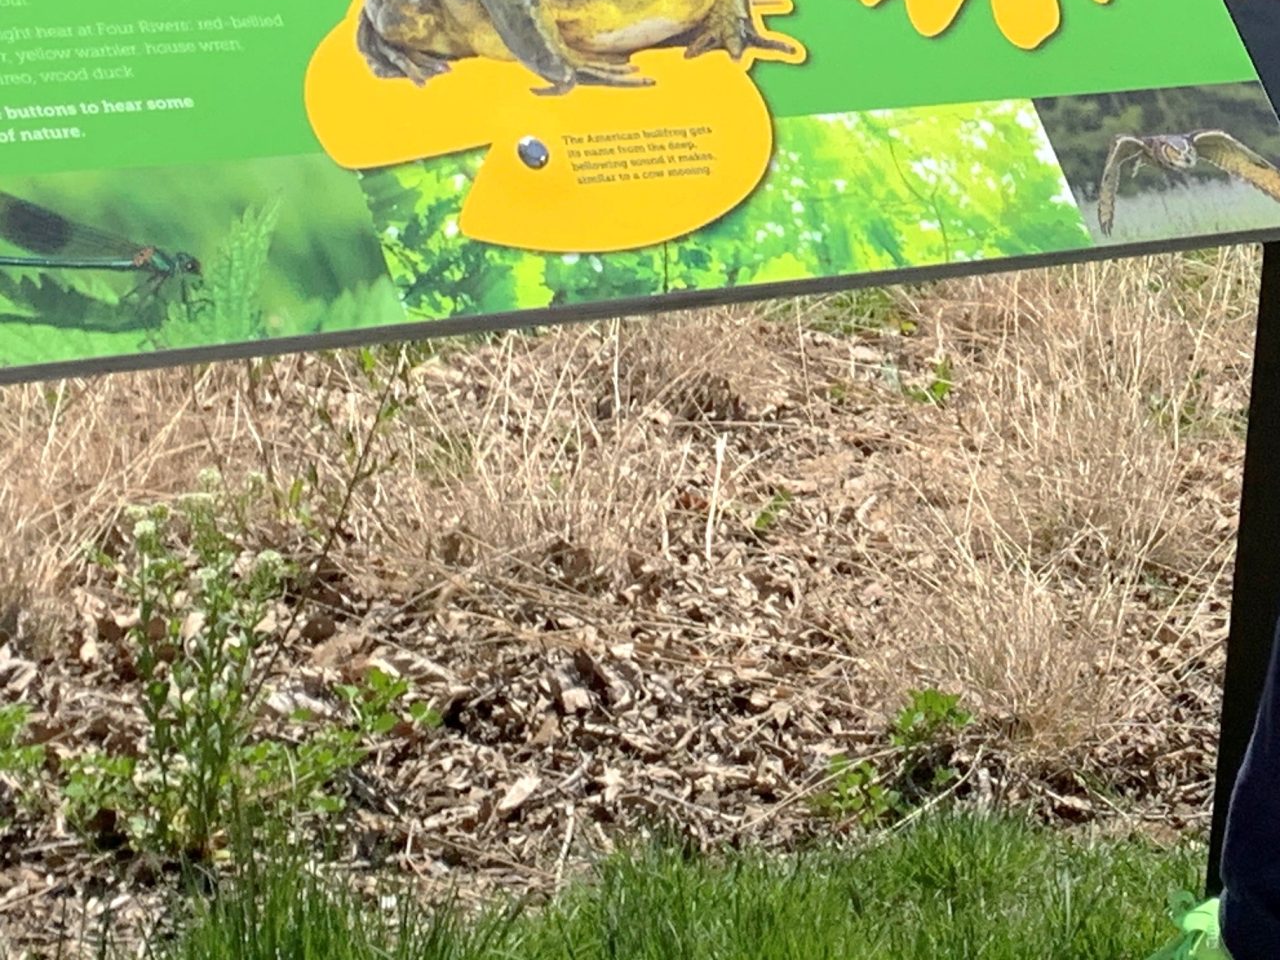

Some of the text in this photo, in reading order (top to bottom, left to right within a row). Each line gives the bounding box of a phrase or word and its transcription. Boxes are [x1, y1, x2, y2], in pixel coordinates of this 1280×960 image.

[34, 25, 73, 39] hear
[77, 24, 94, 37] at
[95, 21, 134, 36] Four
[198, 13, 285, 31] red-bellied
[15, 47, 71, 65] yellow
[144, 42, 196, 55] house
[38, 67, 89, 83] wood
[92, 64, 135, 80] duck
[4, 96, 195, 120] buttons to hear some
[0, 126, 86, 144] of nature.
[561, 125, 712, 145] The American bullfrog gets
[567, 148, 581, 159] its
[583, 146, 615, 158] name
[617, 143, 646, 154] from
[647, 140, 666, 152] the
[571, 157, 628, 172] bellowing
[630, 154, 665, 167] sound
[667, 153, 678, 164] it
[577, 171, 616, 185] similar
[618, 171, 631, 182] to
[642, 168, 665, 179] cow
